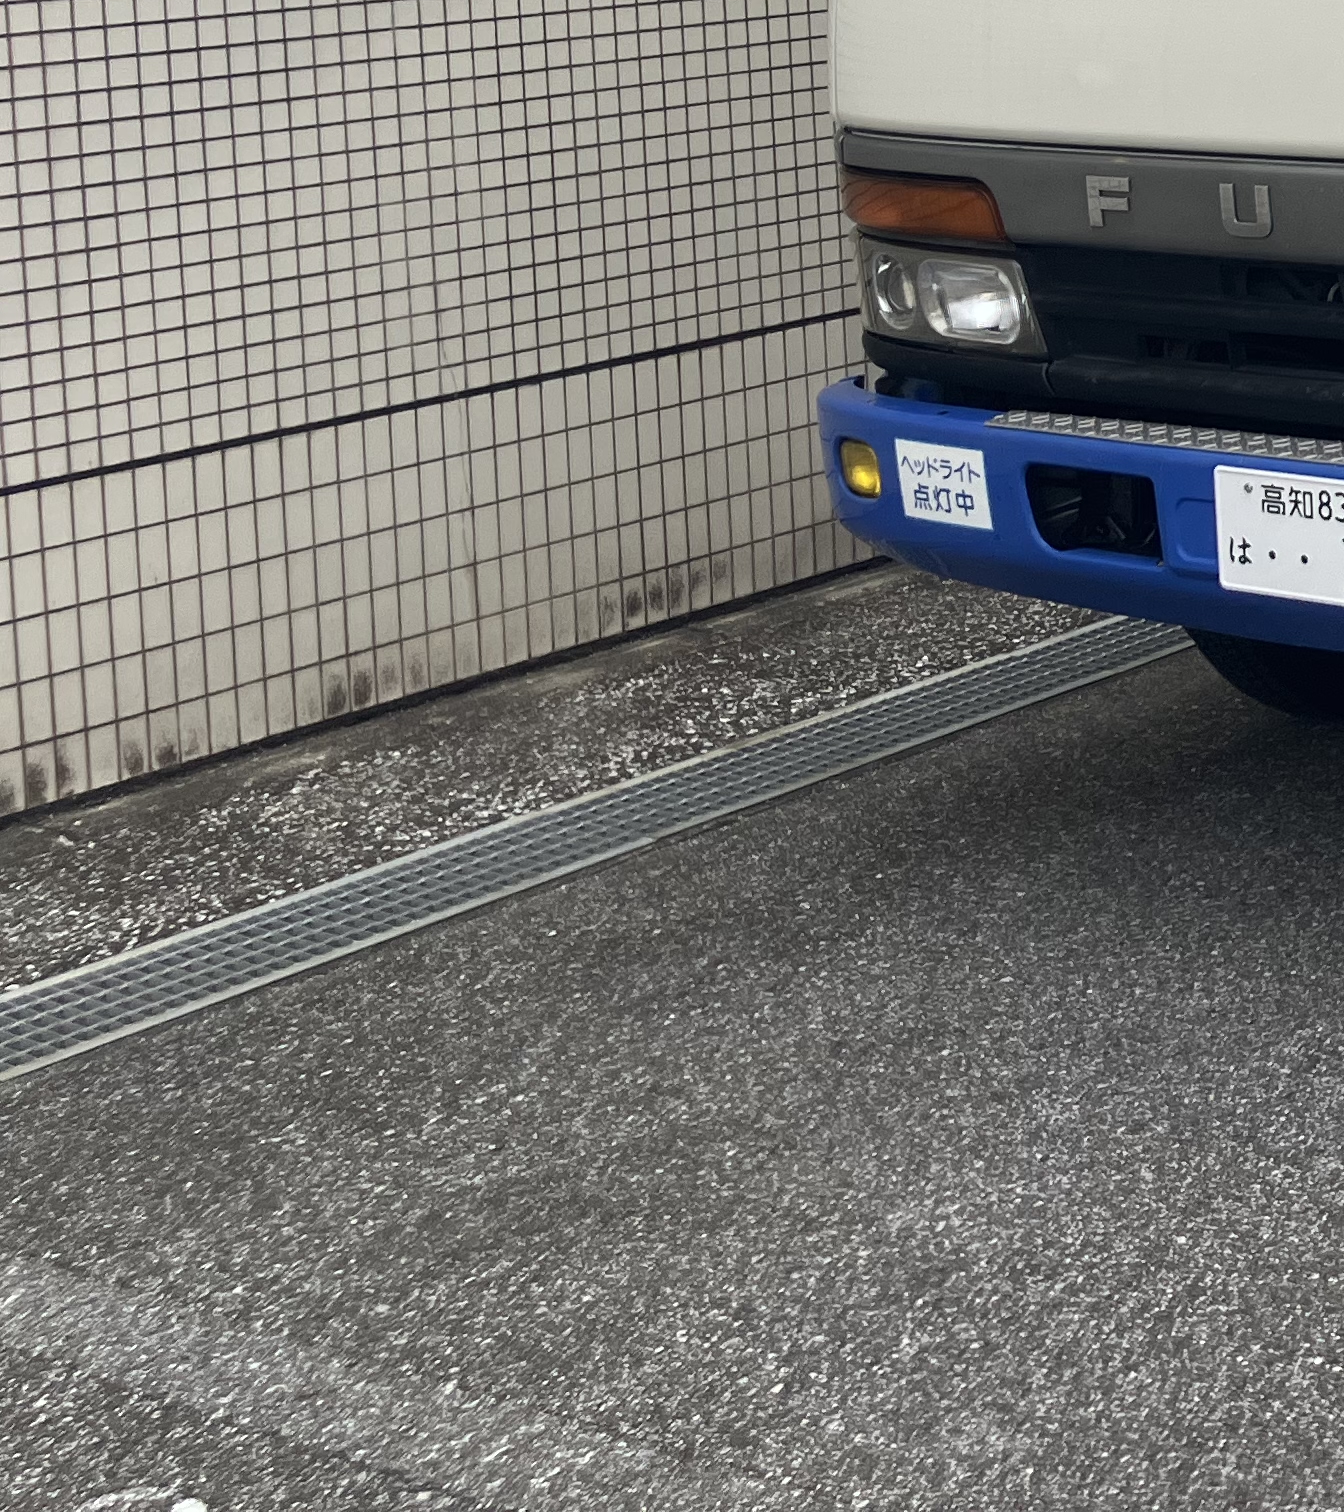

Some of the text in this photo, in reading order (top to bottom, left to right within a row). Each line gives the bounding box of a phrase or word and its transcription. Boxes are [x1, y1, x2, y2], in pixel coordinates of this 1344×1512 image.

[900, 455, 982, 485] ヘッドライト
[913, 482, 976, 518] 点灯中
